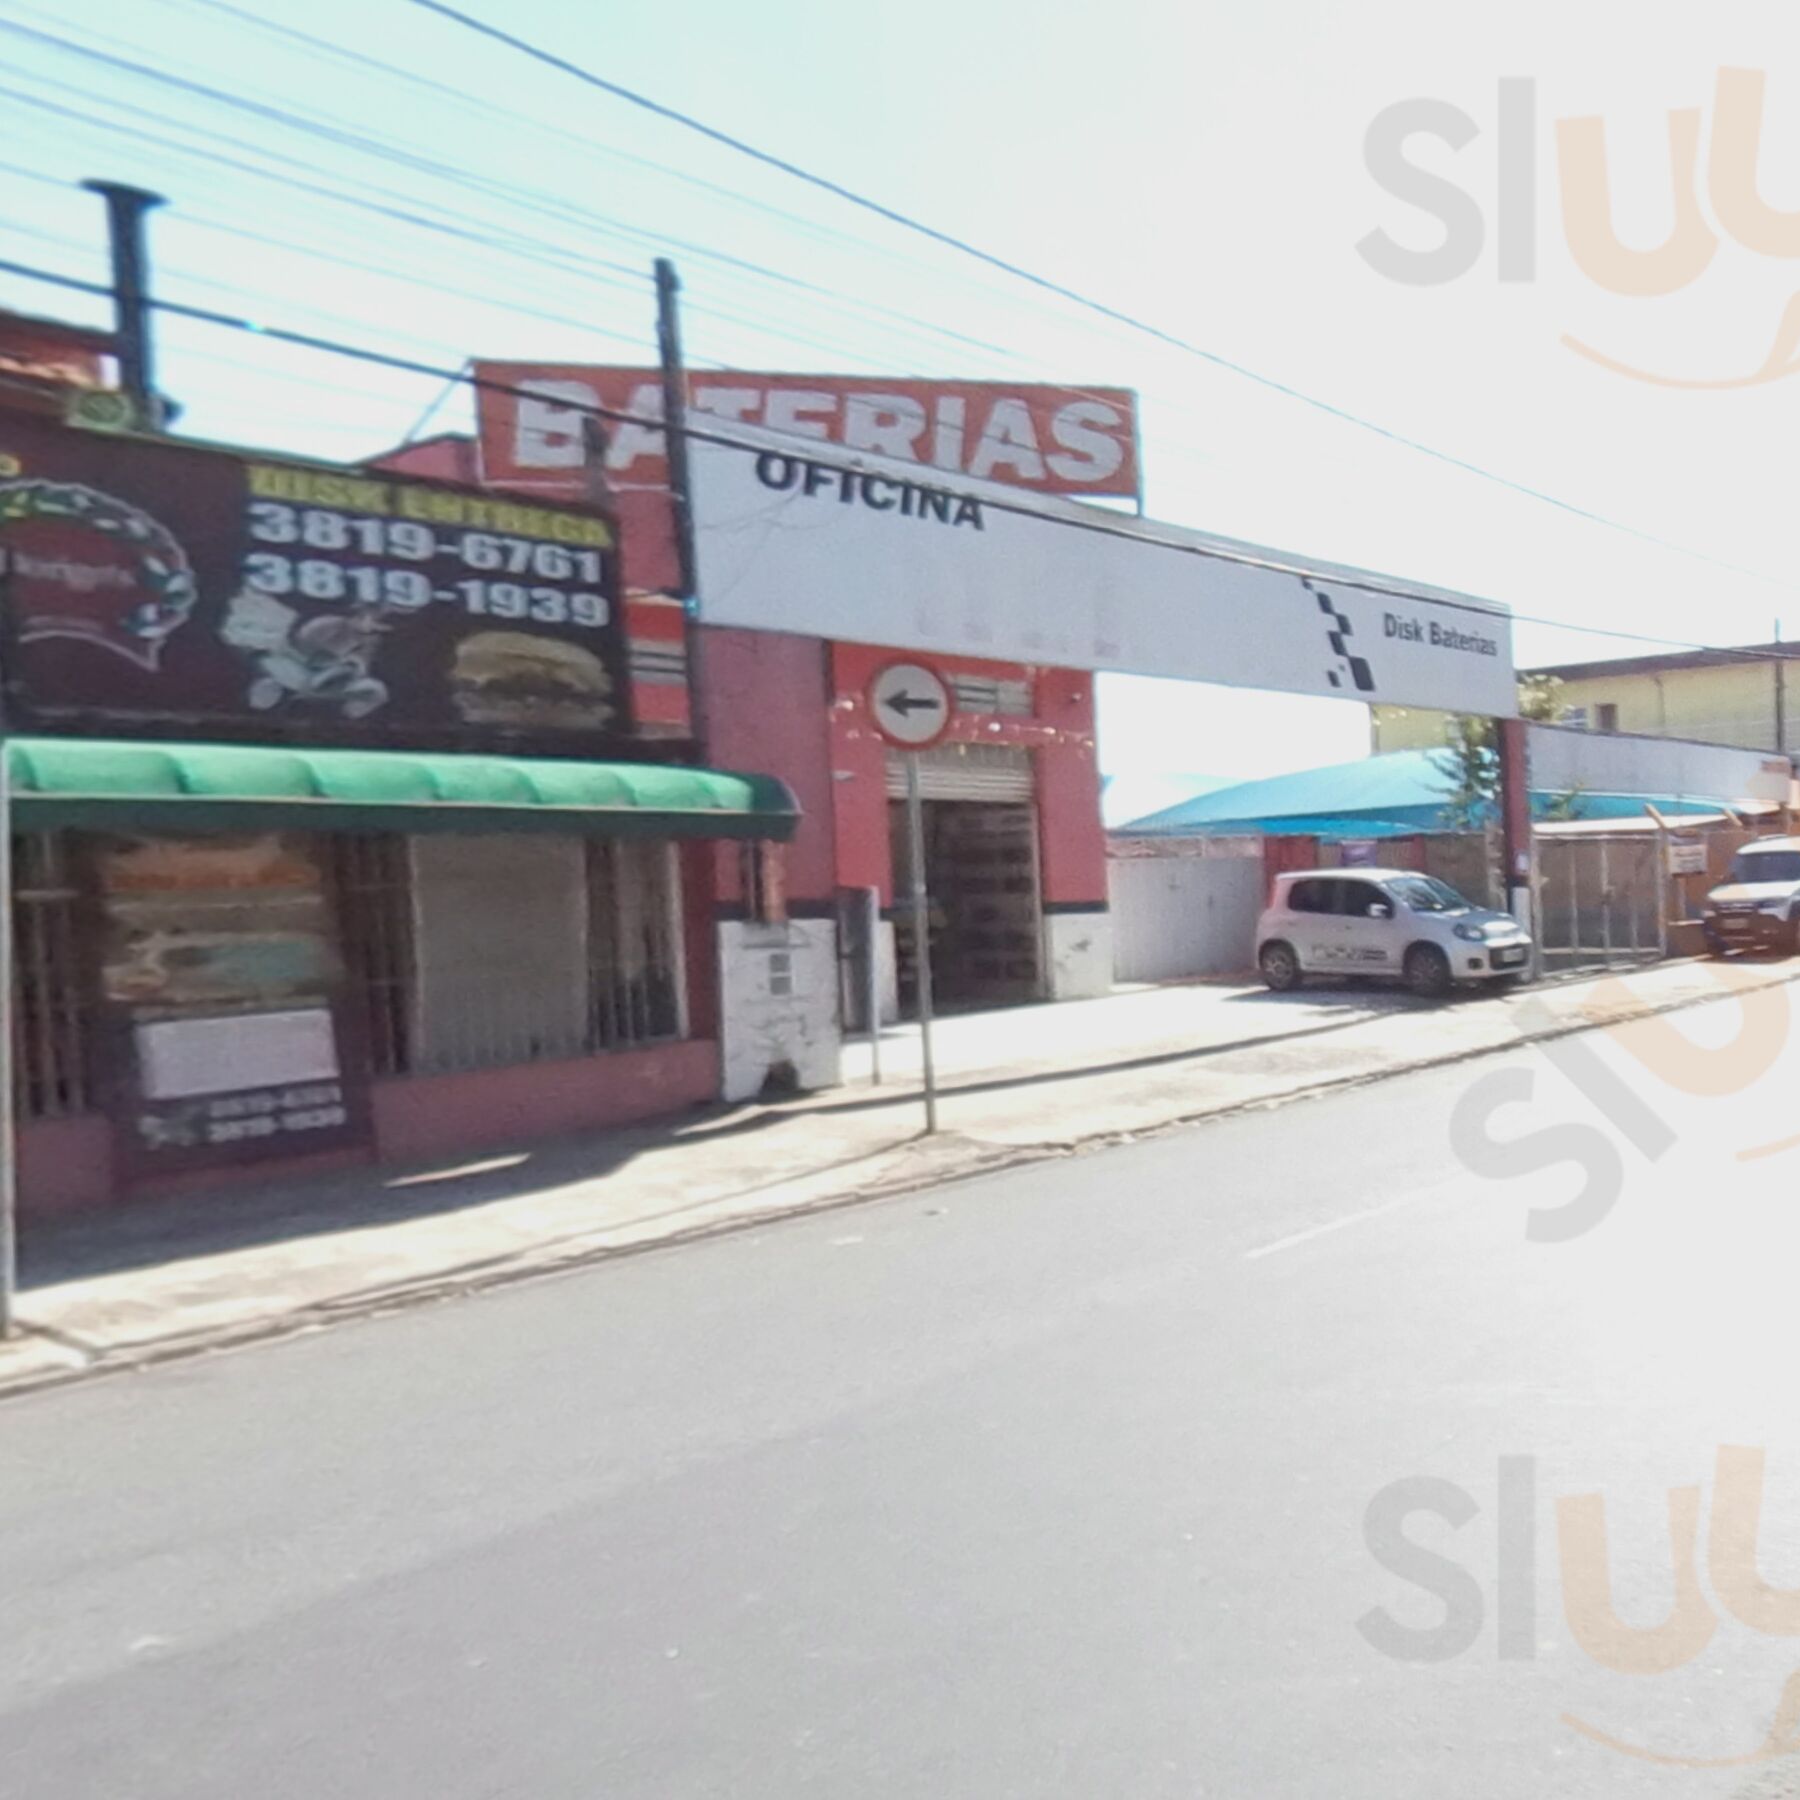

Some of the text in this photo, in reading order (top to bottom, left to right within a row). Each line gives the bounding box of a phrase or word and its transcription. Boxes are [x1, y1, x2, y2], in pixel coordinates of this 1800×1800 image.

[756, 450, 985, 532] OFICINA
[248, 502, 601, 584] 3819-6761
[244, 552, 610, 628] 3819-1939
[1383, 611, 1498, 657] Disk Baterias
